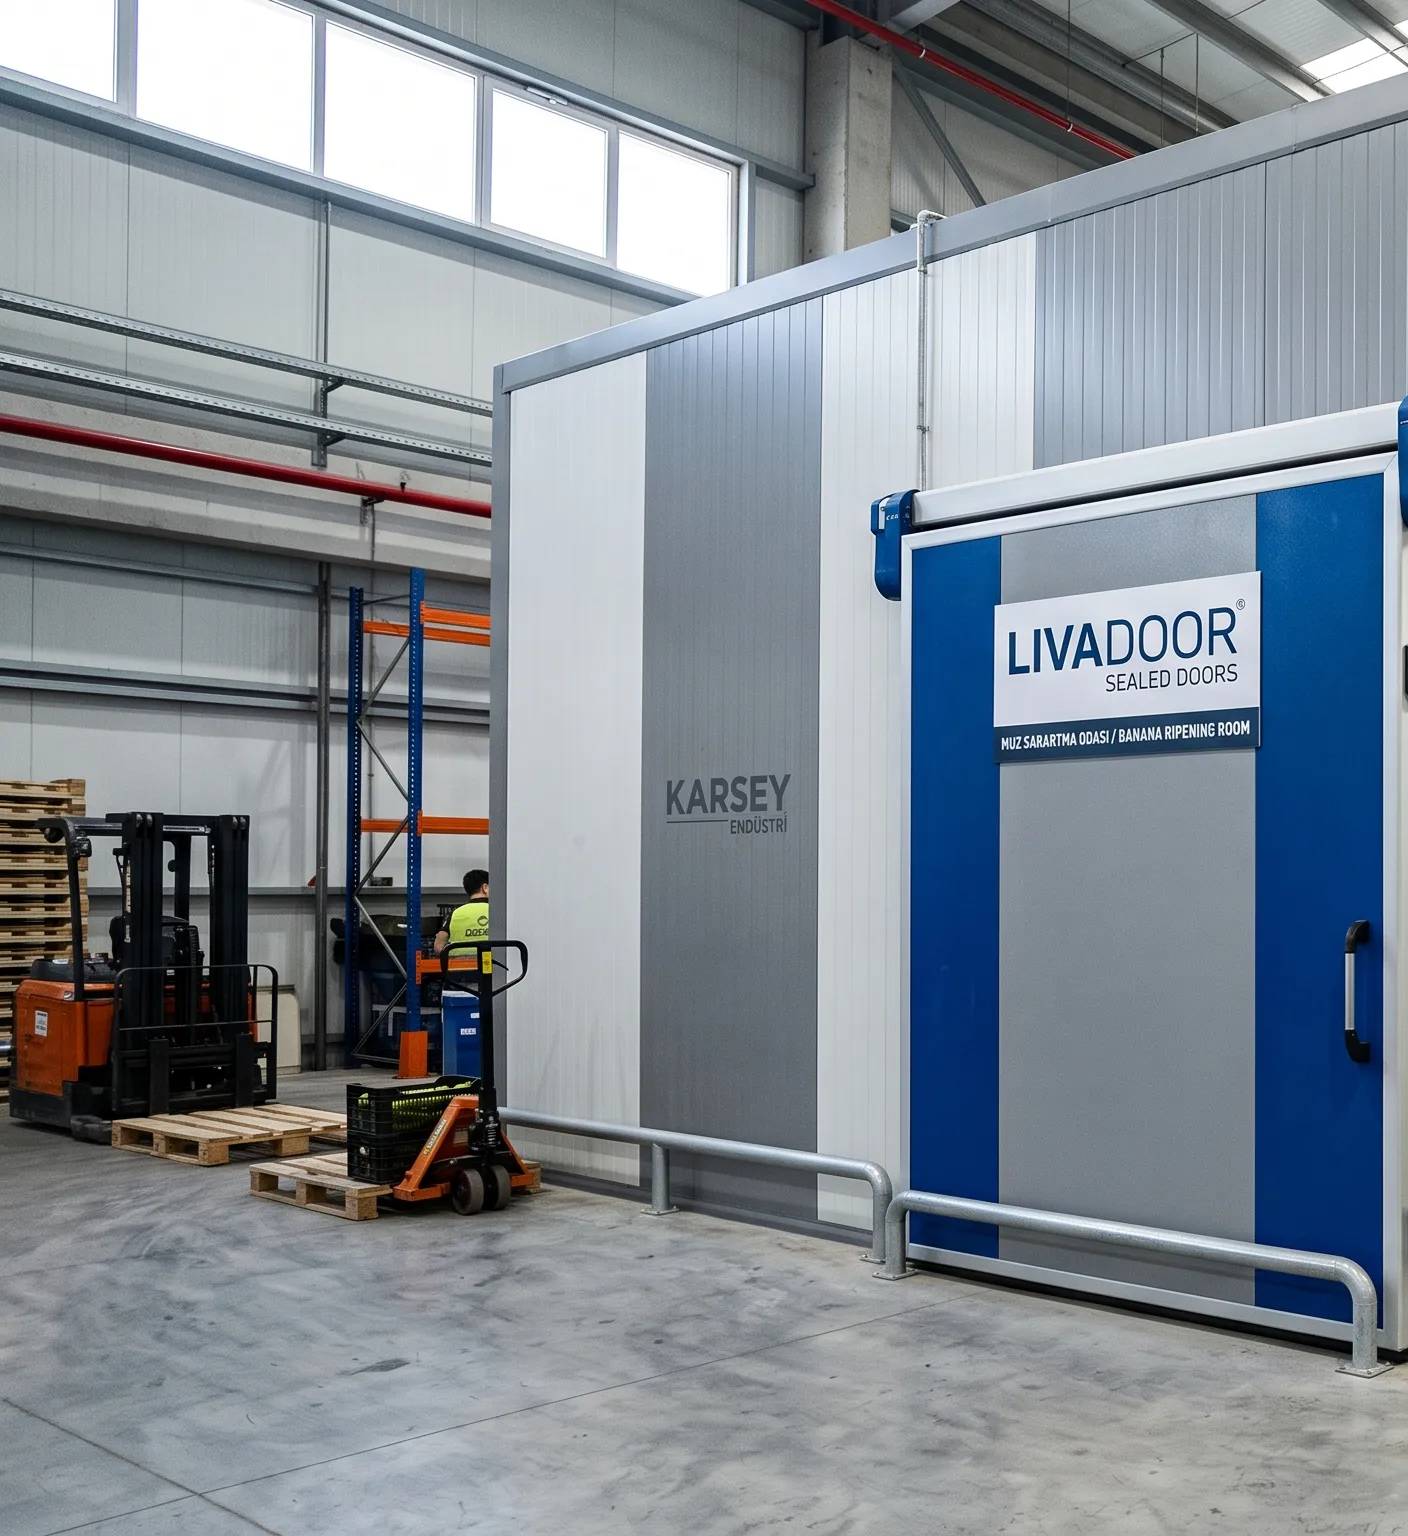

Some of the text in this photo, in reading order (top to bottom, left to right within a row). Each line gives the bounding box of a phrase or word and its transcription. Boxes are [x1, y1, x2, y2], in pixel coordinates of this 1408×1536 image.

[1008, 606, 1238, 676] LIVADOOR
[1105, 663, 1238, 693] SEALED DOORS
[1001, 719, 1250, 751] MUZ SARARTMA ODASI / BANANA RIPENING ROOM
[666, 773, 792, 816] KARSEY
[730, 813, 788, 835] ENDÜSTRİ
